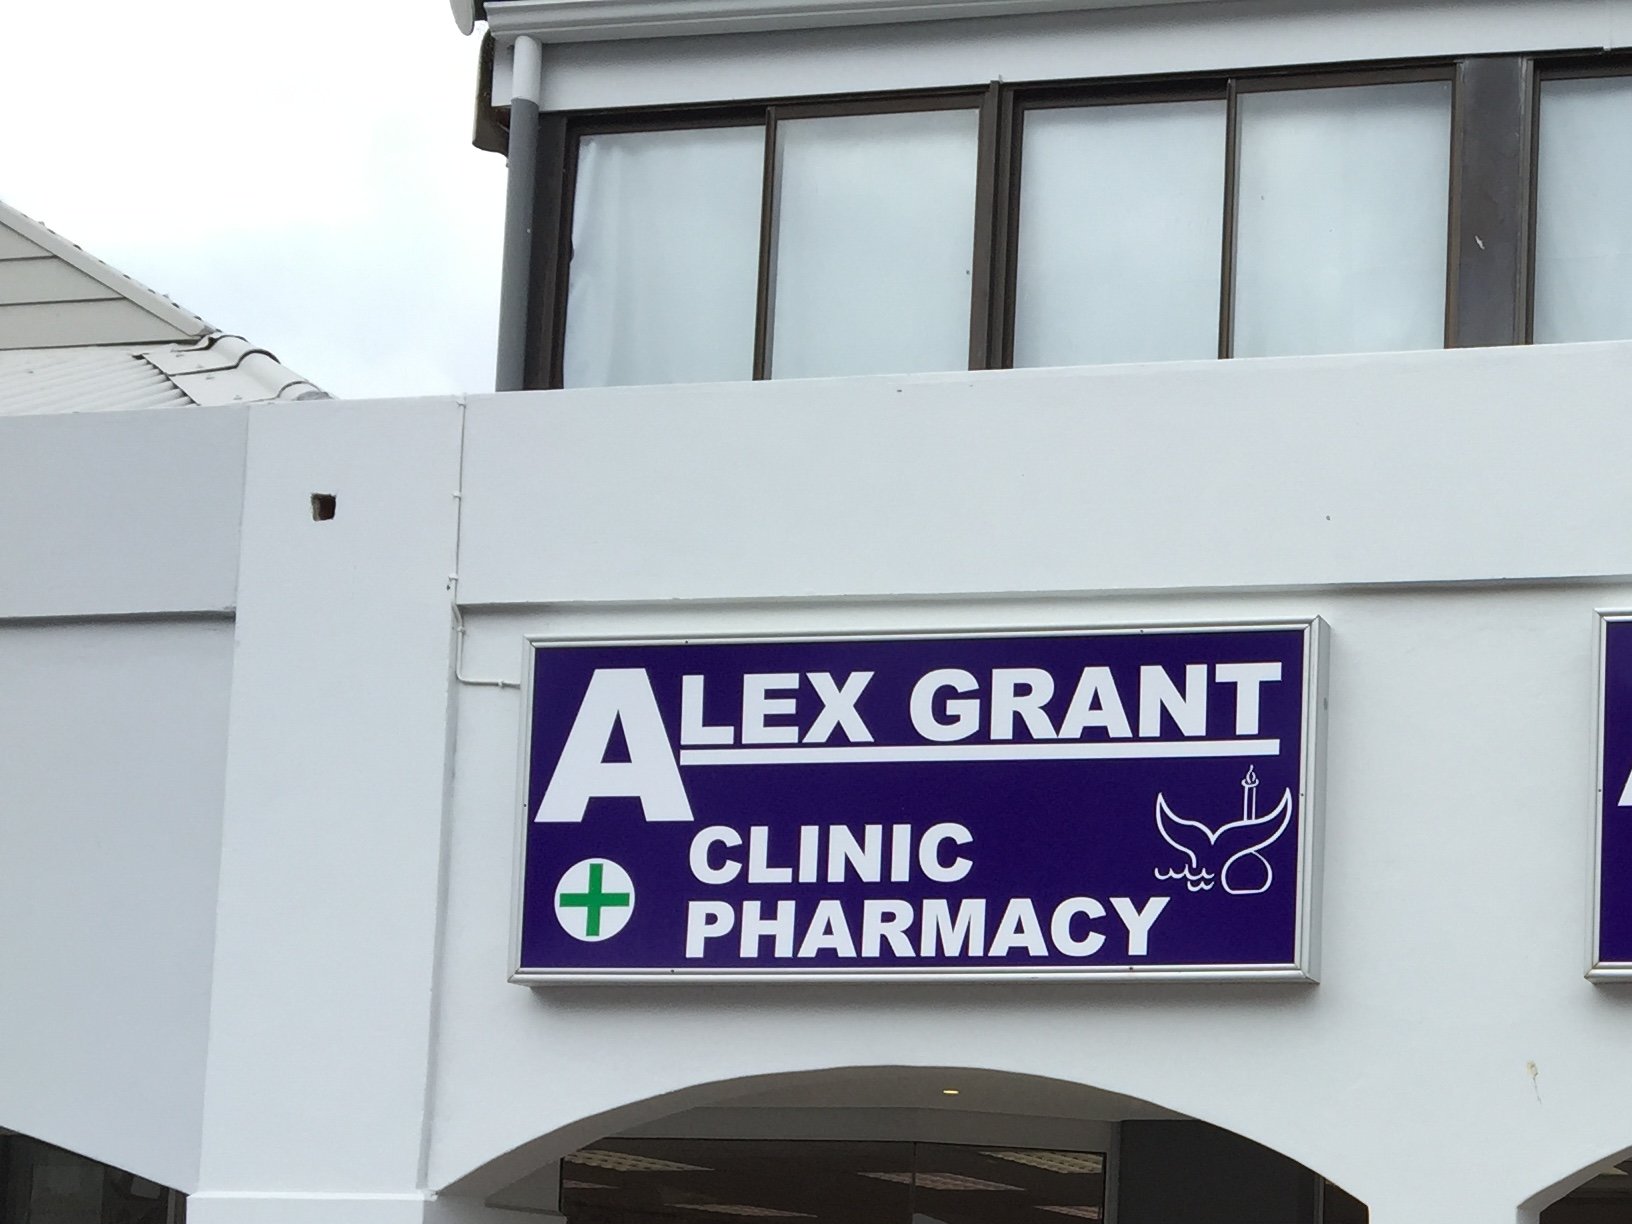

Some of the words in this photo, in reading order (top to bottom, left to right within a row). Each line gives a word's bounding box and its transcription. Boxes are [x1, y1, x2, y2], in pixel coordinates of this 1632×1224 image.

[534, 667, 875, 823] ALEX
[909, 661, 1282, 741] GRANT
[688, 823, 973, 884] CLINIC
[685, 896, 1170, 959] PHARMACY
